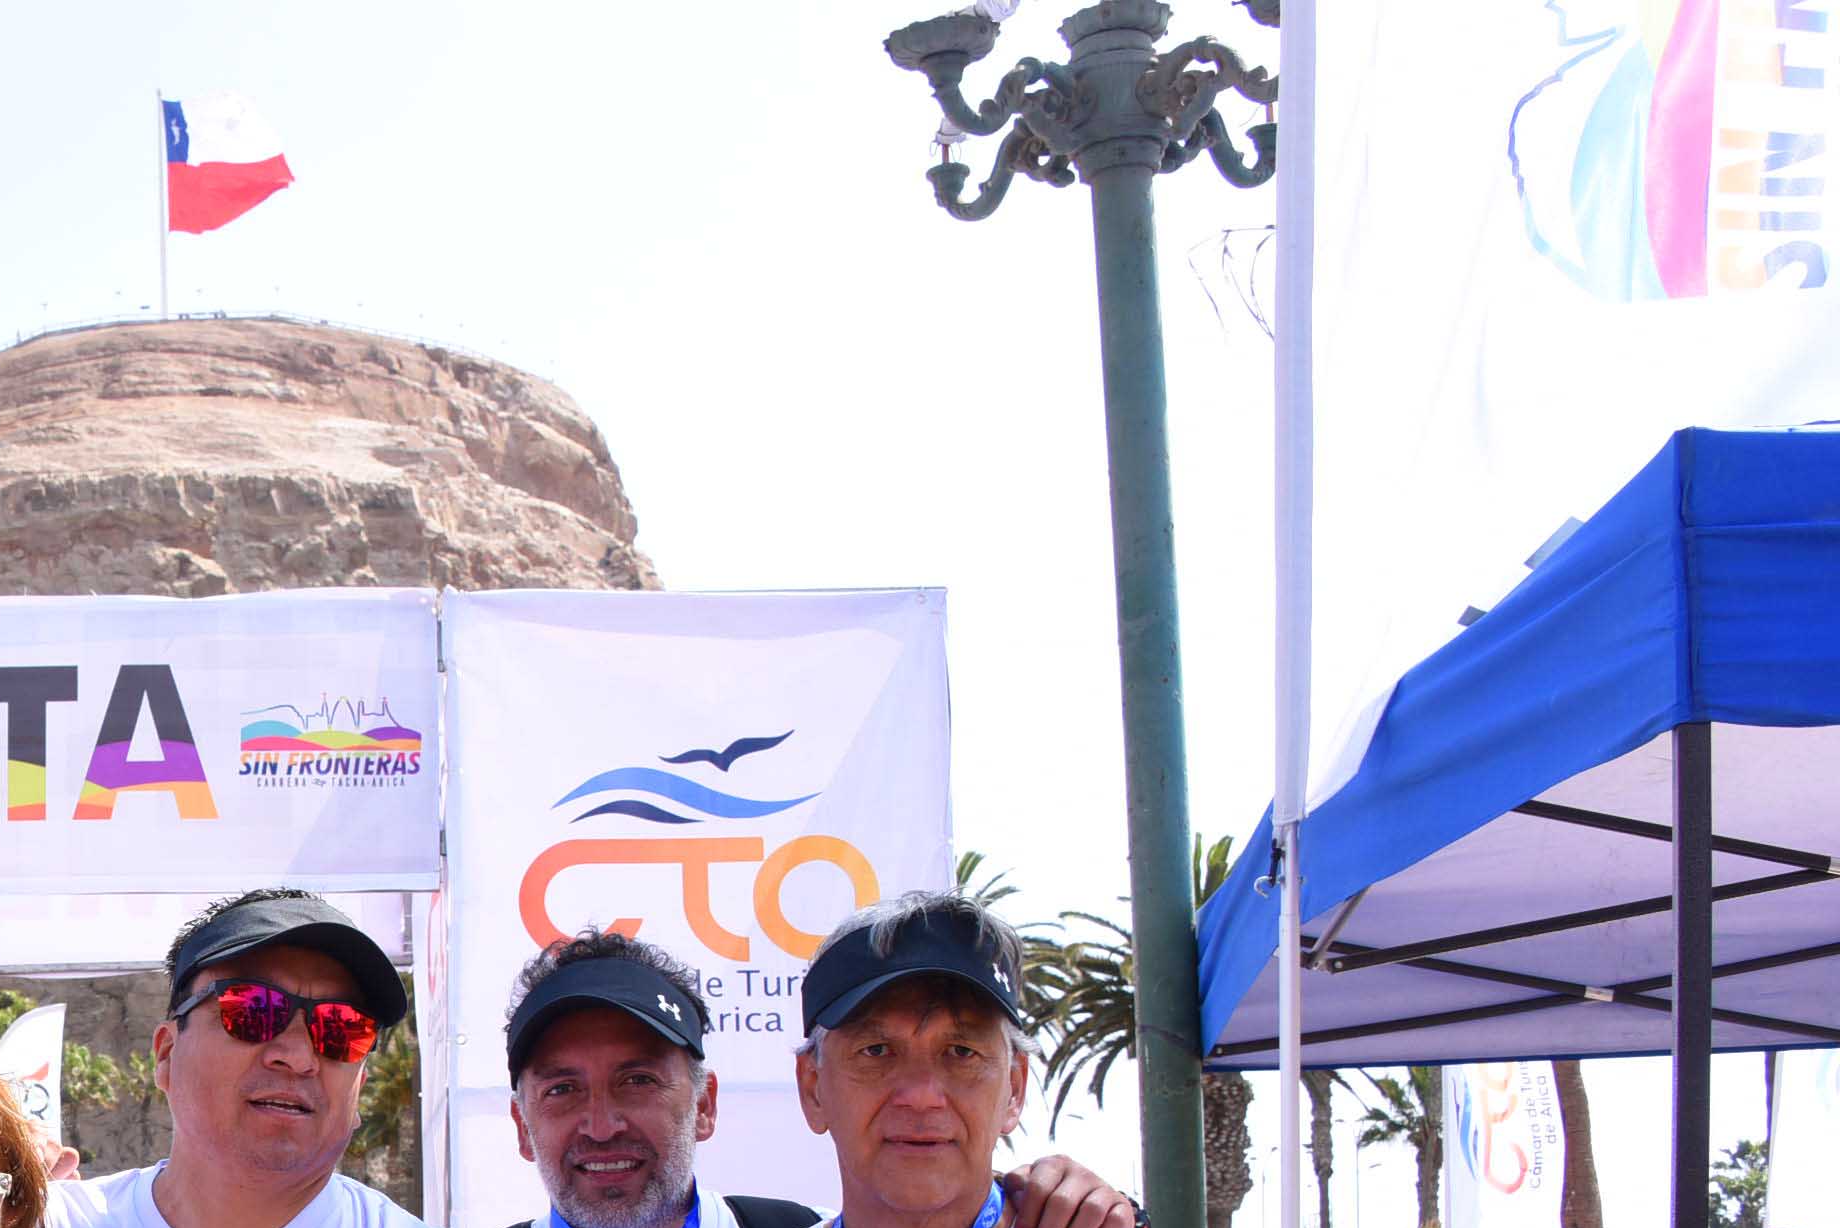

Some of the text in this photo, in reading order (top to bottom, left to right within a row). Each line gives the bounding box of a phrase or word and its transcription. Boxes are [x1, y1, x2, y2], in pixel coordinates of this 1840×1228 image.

[239, 751, 421, 775] SIN FRONTERAS
[741, 969, 804, 998] Turi
[1536, 1074, 1553, 1116] Arica
[1529, 1122, 1542, 1190] Cámara
